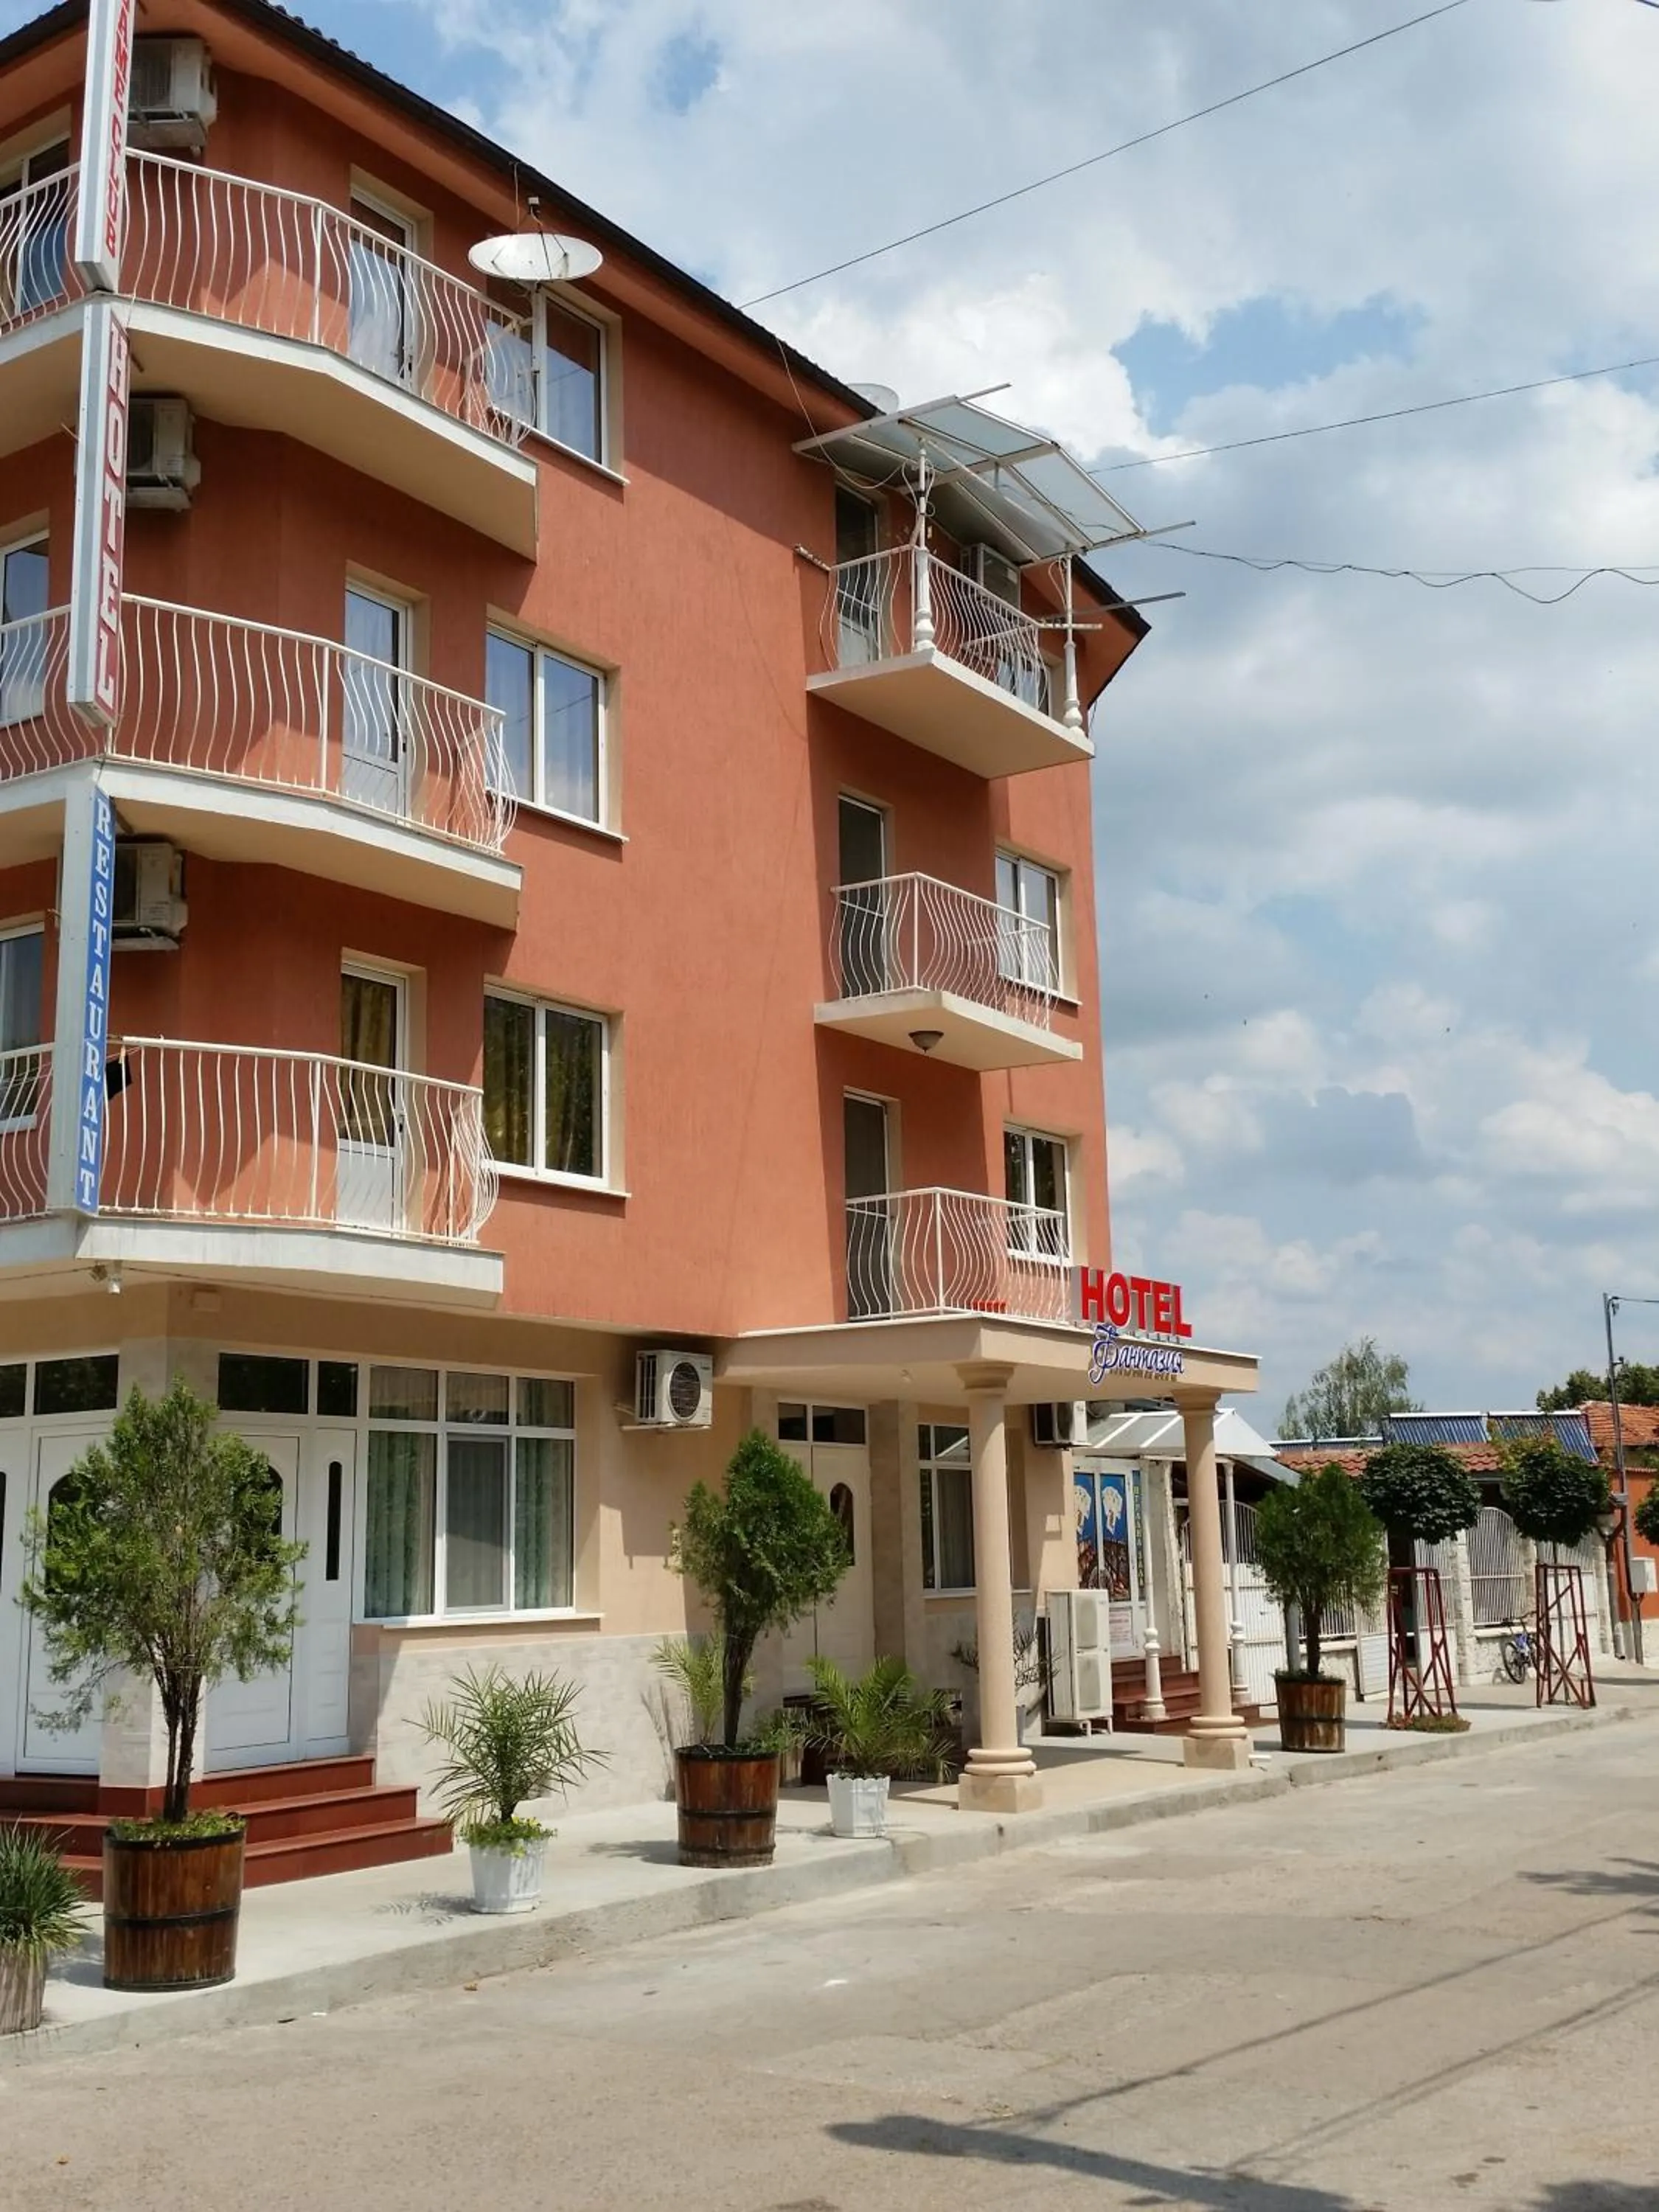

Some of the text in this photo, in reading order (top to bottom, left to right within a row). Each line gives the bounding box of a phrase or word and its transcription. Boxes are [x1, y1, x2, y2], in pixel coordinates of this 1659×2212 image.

[97, 319, 128, 712] HOTEL
[79, 796, 113, 1208] RESTAURANT
[1079, 1265, 1193, 1338] HOTEL
